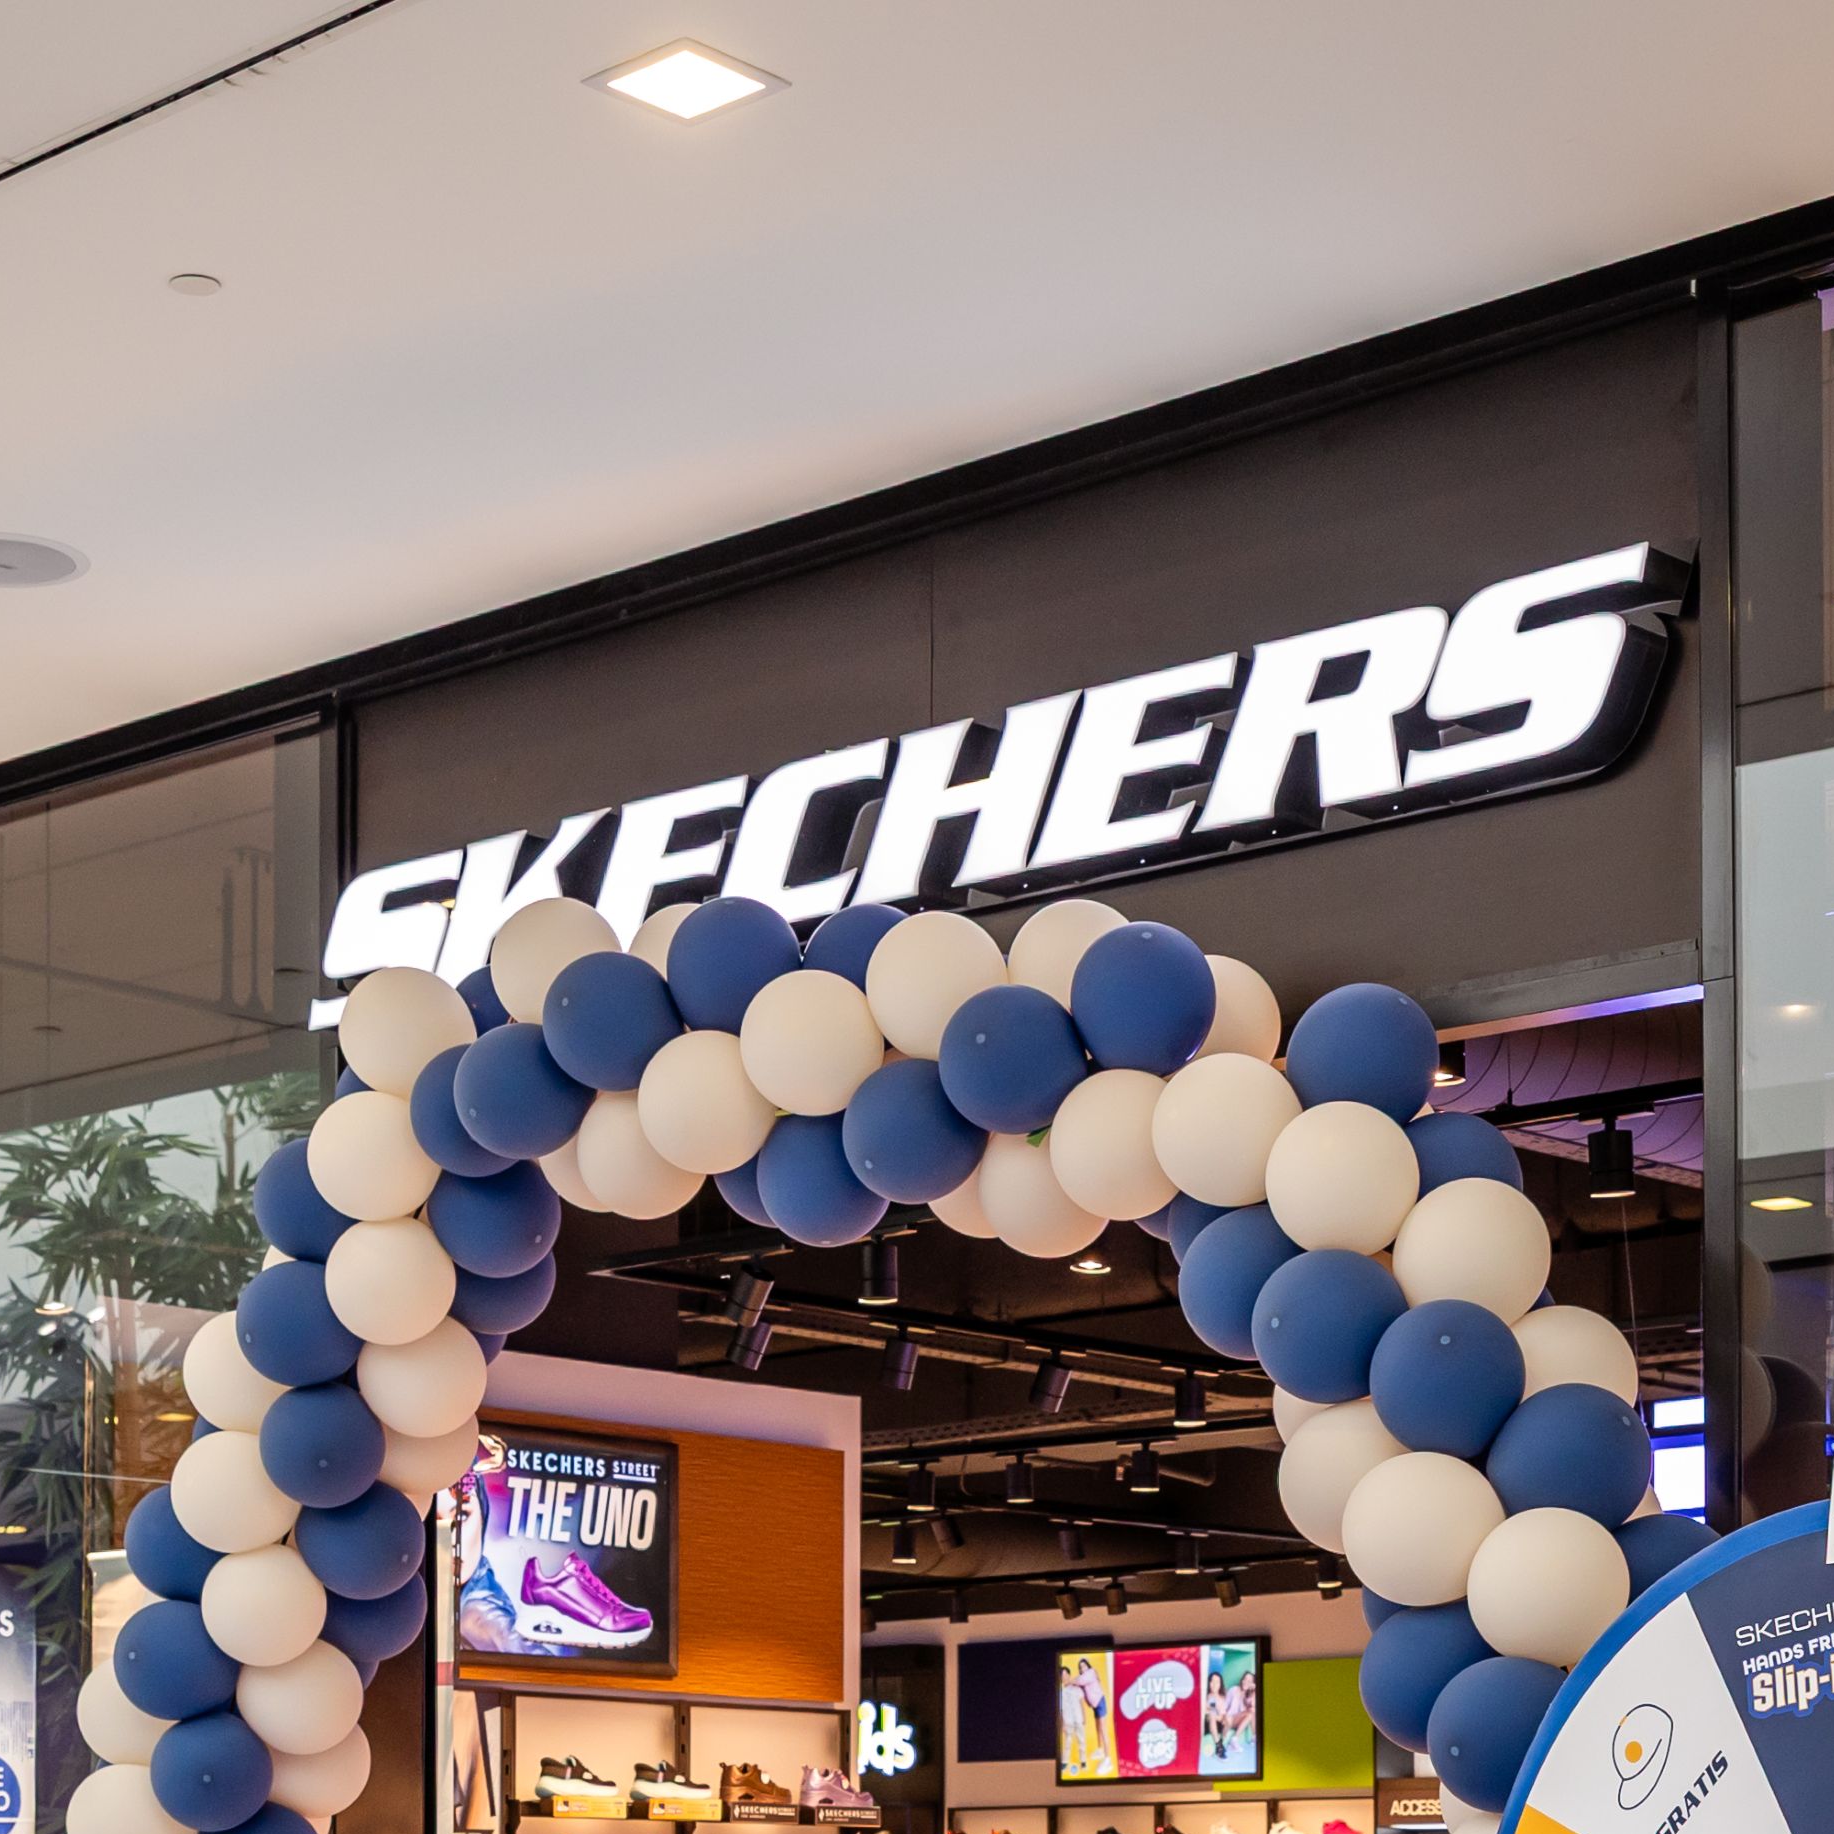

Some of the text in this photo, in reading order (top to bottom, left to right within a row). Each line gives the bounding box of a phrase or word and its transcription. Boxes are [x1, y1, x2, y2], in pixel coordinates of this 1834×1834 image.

[308, 541, 1651, 1031] SKECHERS
[507, 1449, 657, 1477] SKECHERS STREET
[507, 1476, 657, 1550] THE UNO
[1743, 1643, 1804, 1676] HANDS
[1138, 1677, 1173, 1693] LIVE
[1136, 1693, 1177, 1710] IT UP
